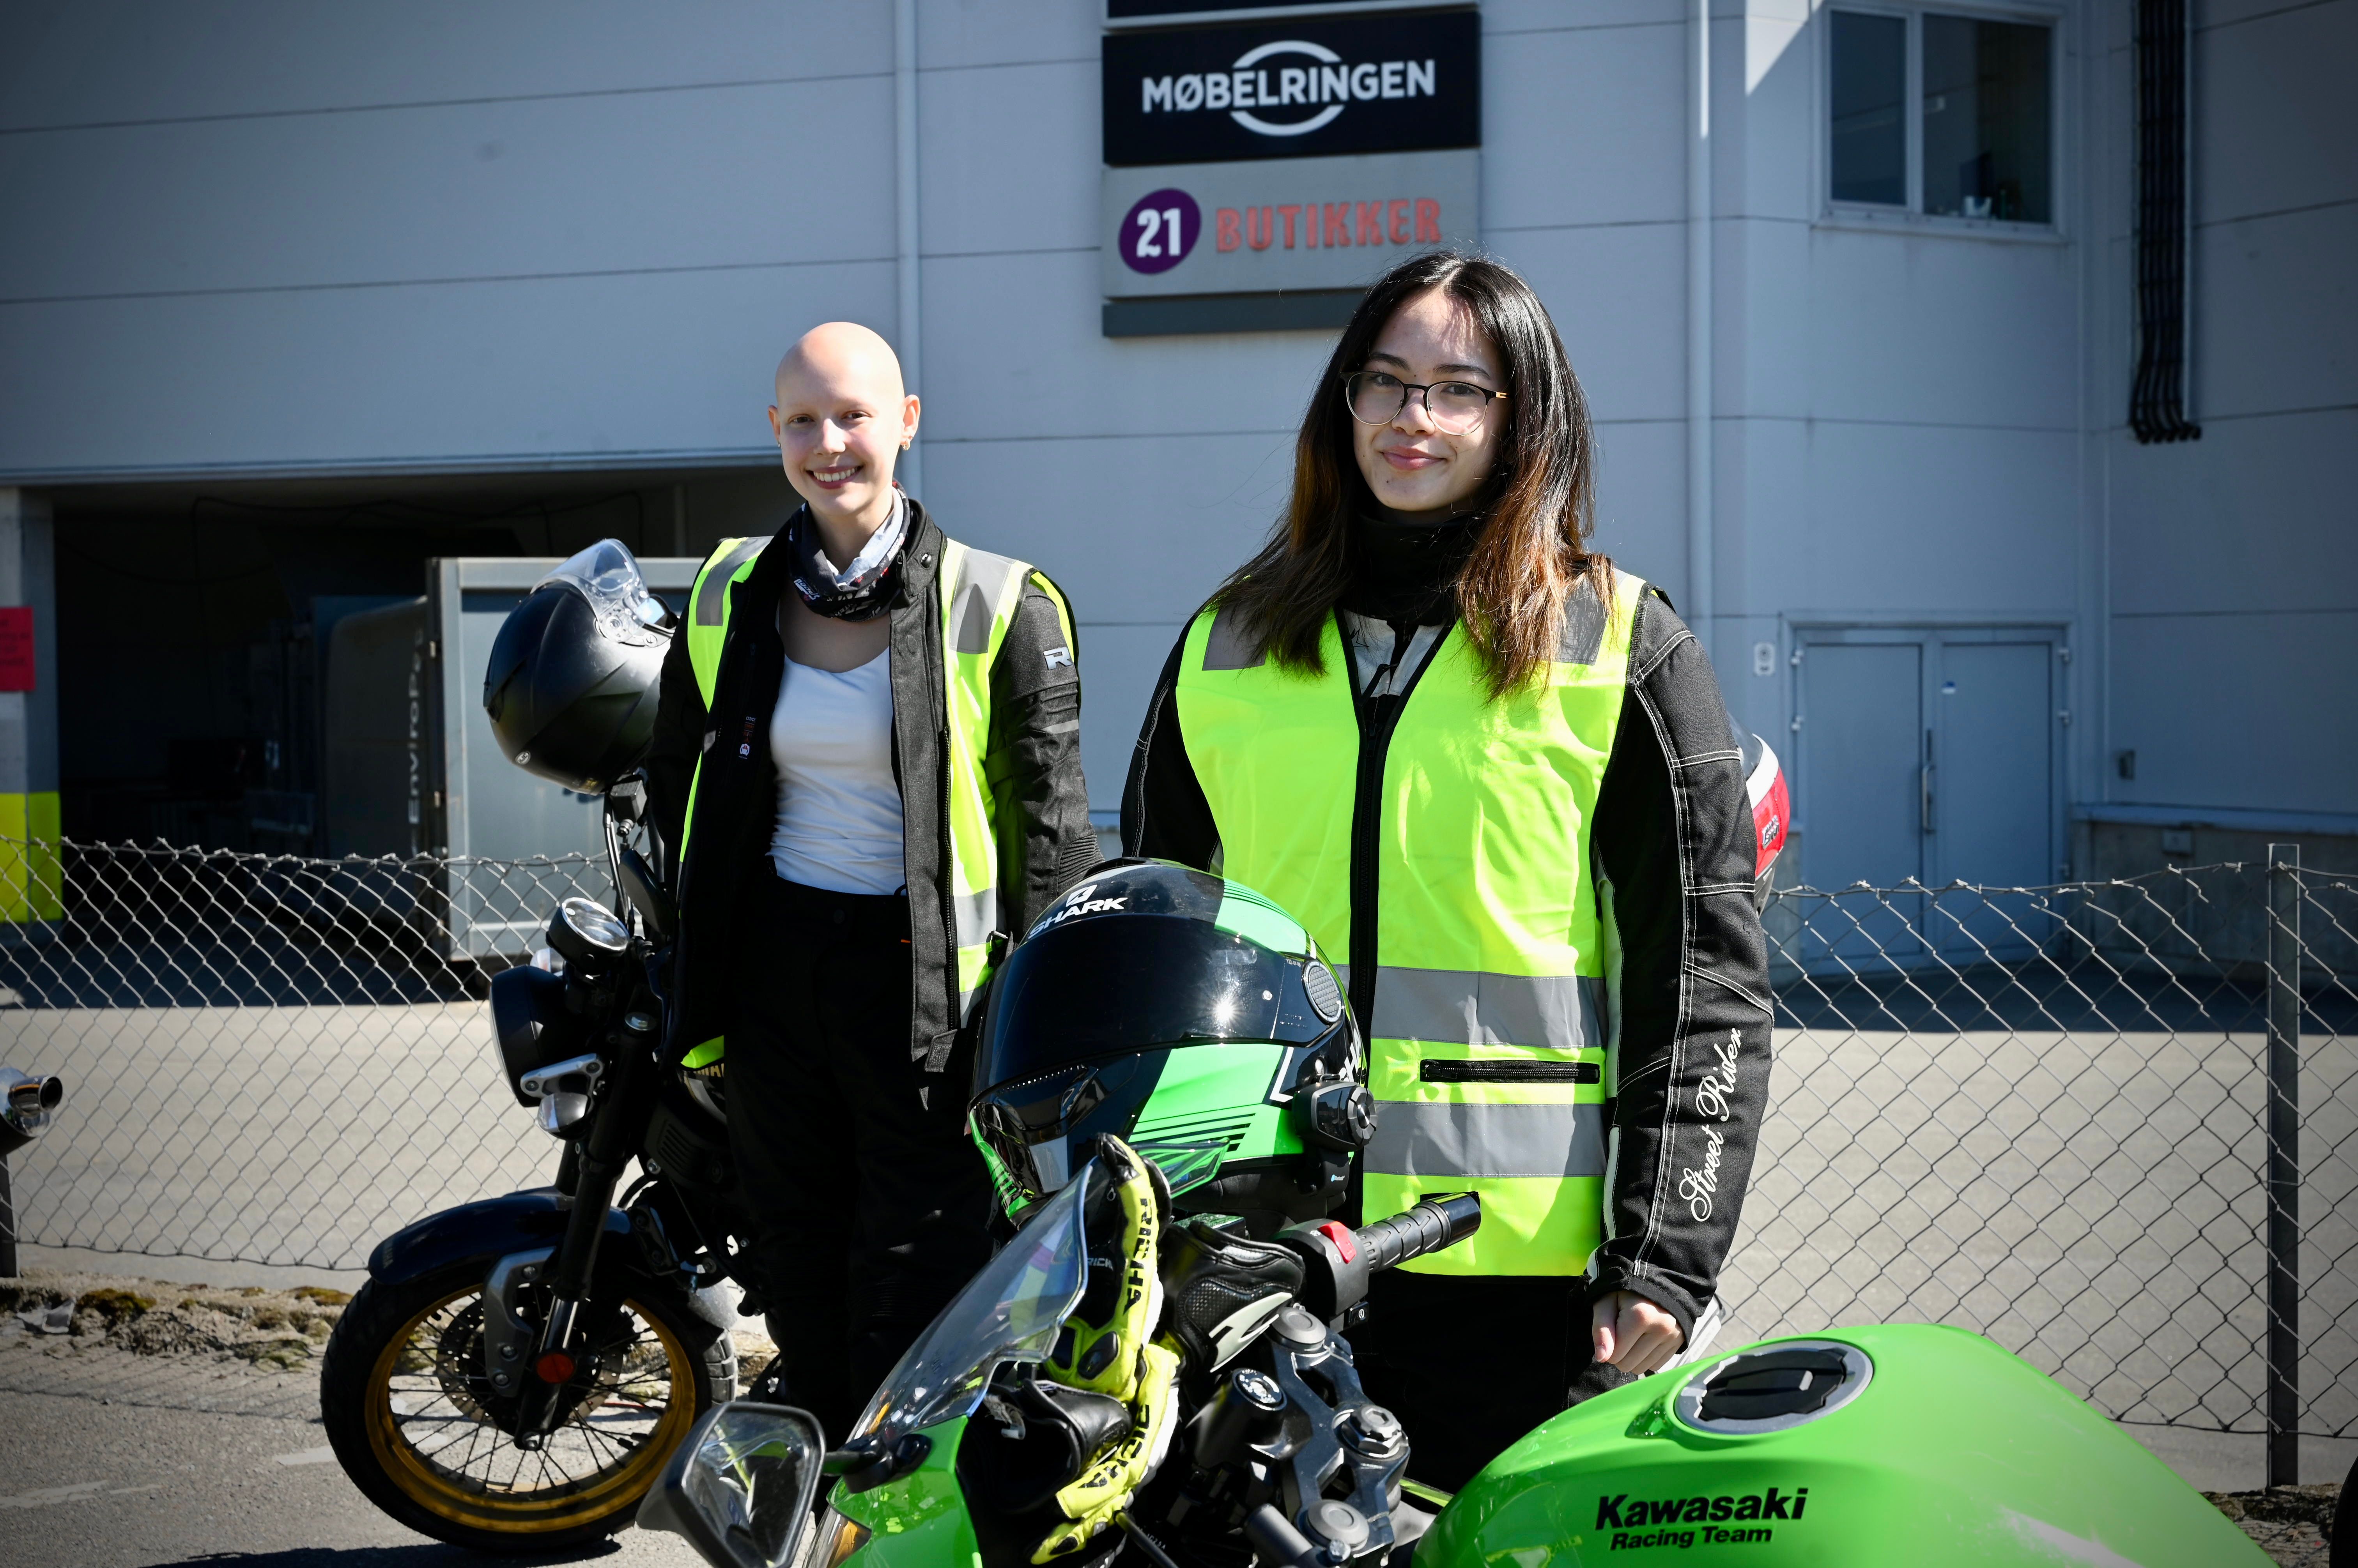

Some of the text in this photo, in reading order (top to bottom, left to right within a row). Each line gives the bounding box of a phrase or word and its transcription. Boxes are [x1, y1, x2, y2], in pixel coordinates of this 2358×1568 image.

[1142, 59, 1435, 113] MØBELRINGEN
[1136, 198, 1443, 258] 21 BUTIKKER
[1028, 897, 1128, 940] SHARK
[1696, 1027, 1741, 1122] Rider
[1679, 1124, 1724, 1222] Street
[1122, 1198, 1152, 1316] RICHA
[1595, 1487, 1808, 1530] Kawasaki
[1610, 1526, 1772, 1550] Racing Team
